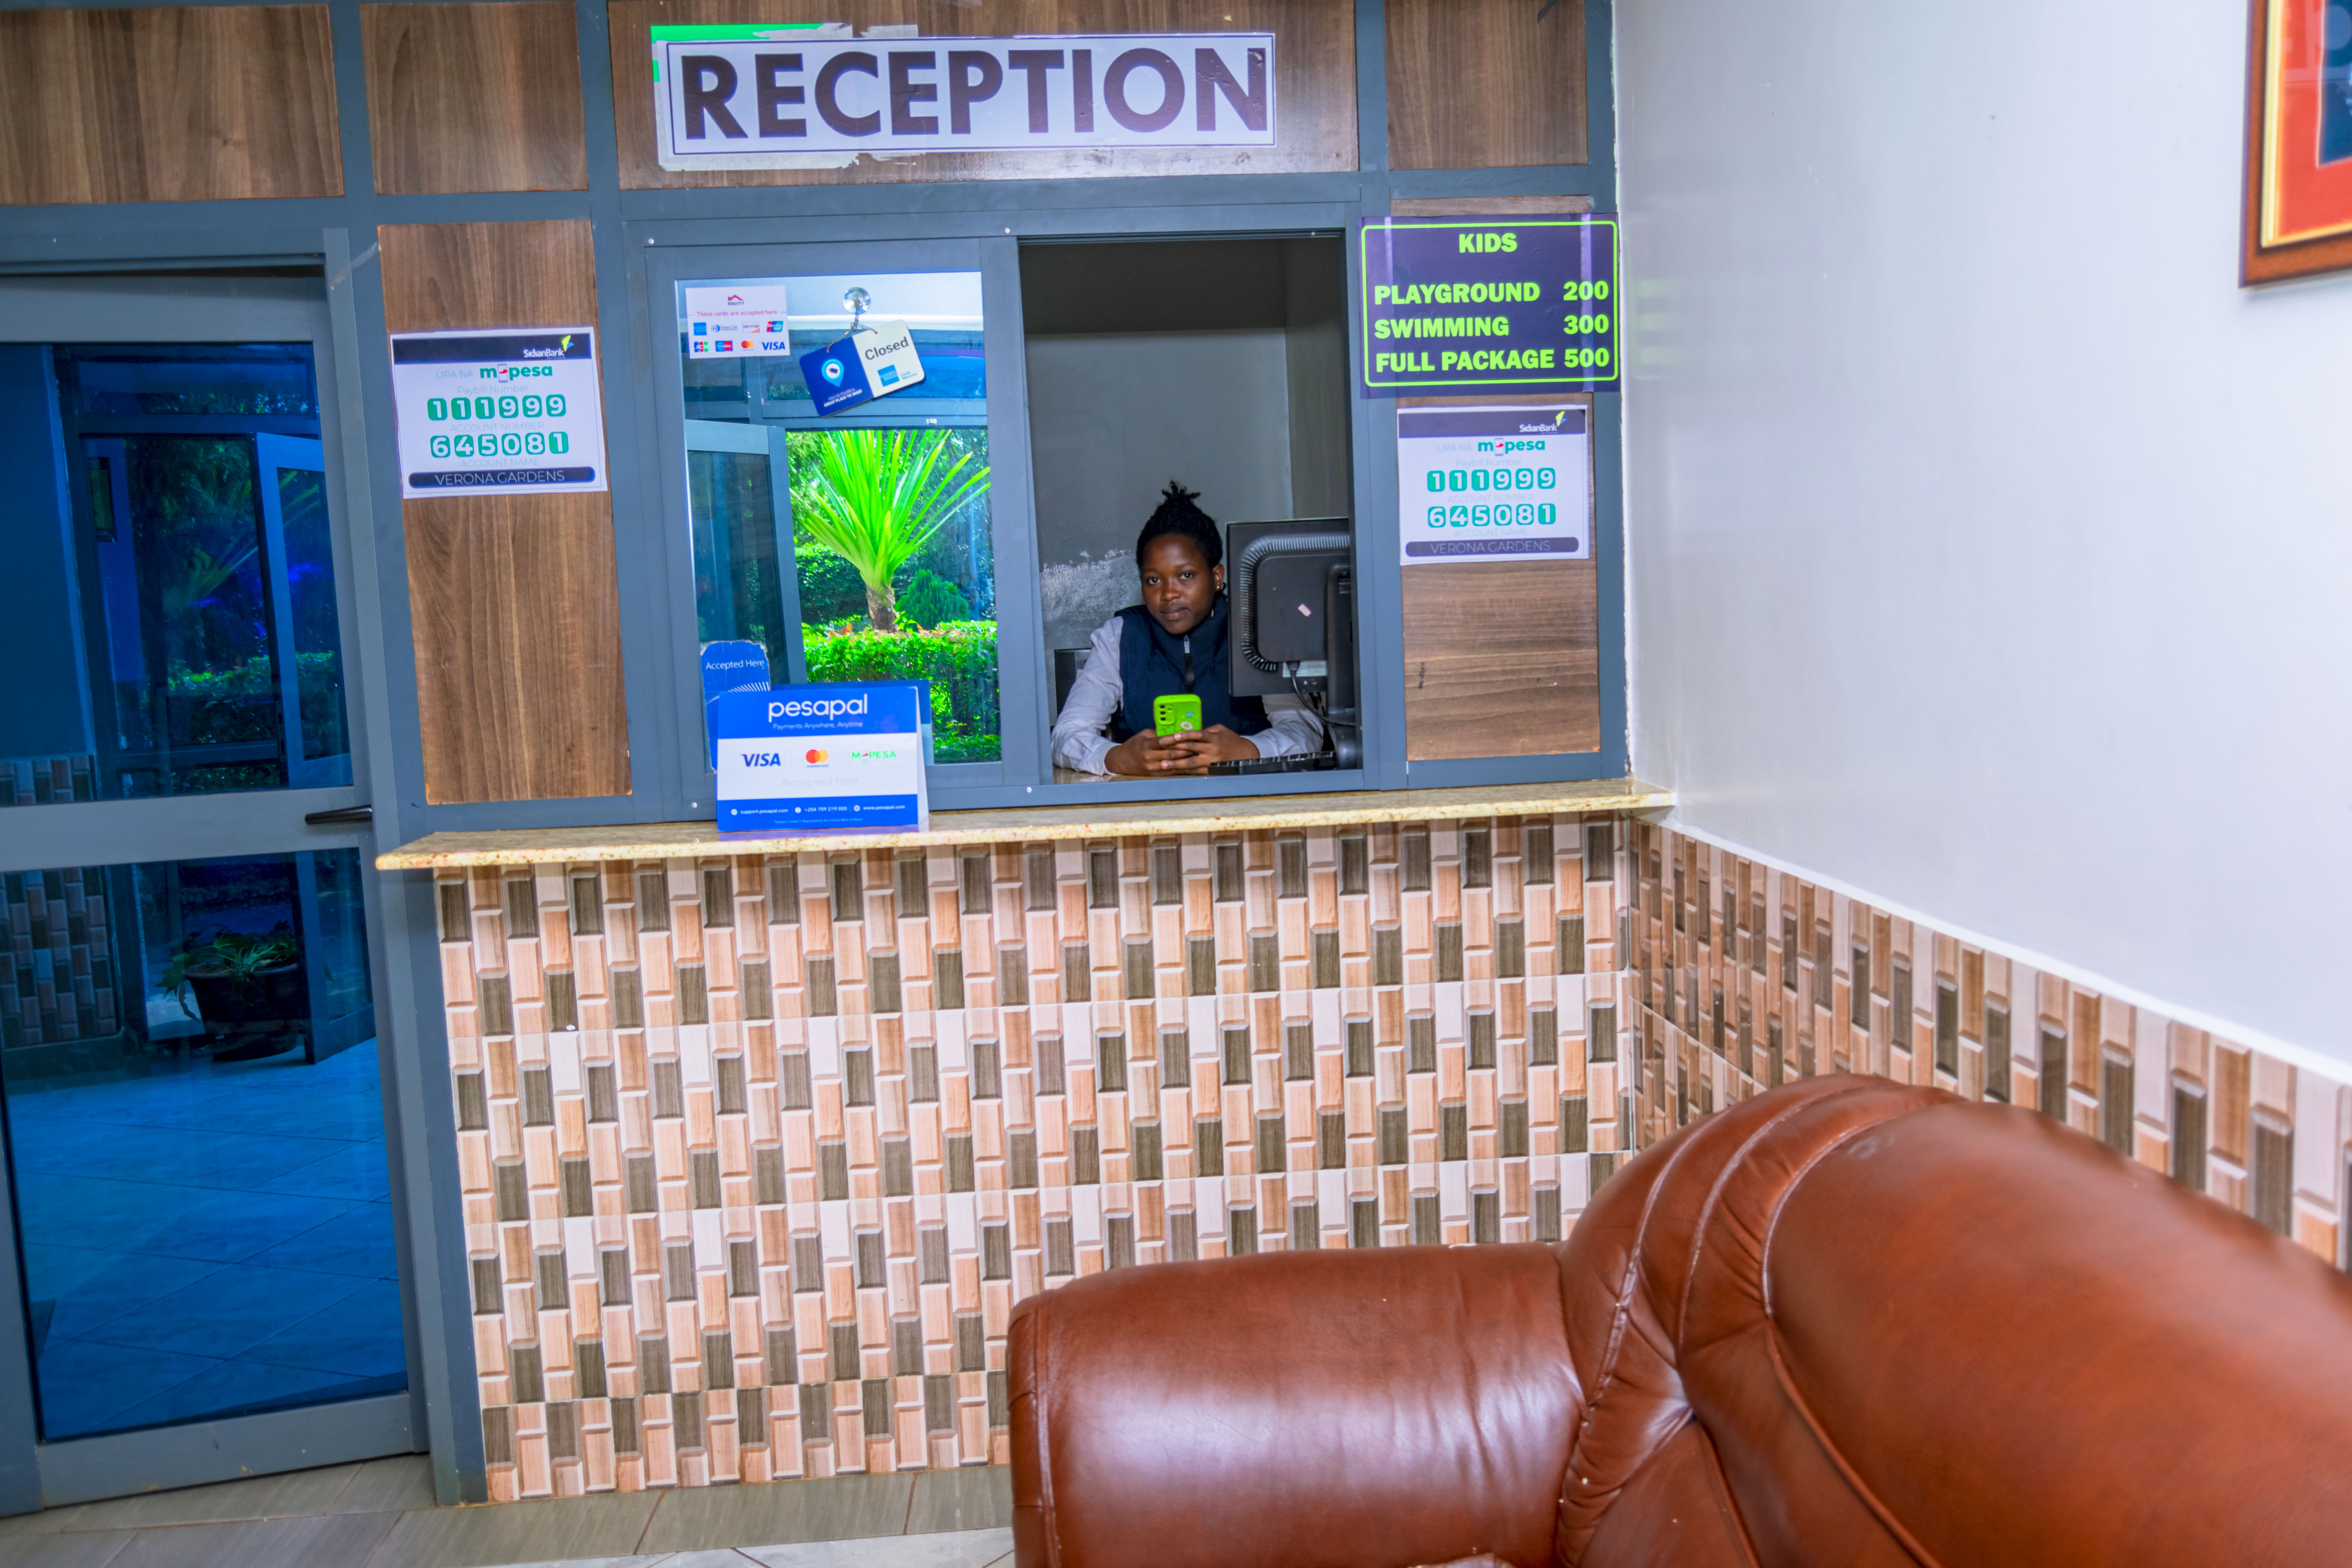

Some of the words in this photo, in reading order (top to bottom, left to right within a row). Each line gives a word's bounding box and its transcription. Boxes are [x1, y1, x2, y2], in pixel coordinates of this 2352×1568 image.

[680, 47, 1268, 140] RECEPTION
[1459, 233, 1517, 253] KIDS
[1374, 282, 1540, 305] PLAYGROUND
[1563, 280, 1608, 301] 200
[1374, 317, 1509, 339] SWIMMING
[1563, 314, 1609, 335] 300
[761, 341, 786, 350] VISA
[865, 336, 909, 360] Closed
[1376, 352, 1435, 372] FULL
[1441, 349, 1555, 371] PACKAGE
[1564, 347, 1610, 368] 500
[436, 370, 457, 379] LIPA
[457, 386, 487, 395] Paybill
[490, 385, 528, 393] Number
[451, 423, 497, 432] ACCOUNT
[501, 422, 544, 430] NUMBER
[1437, 444, 1456, 452] LIPA
[461, 459, 508, 468] ACCOUNT
[1456, 459, 1483, 468] Paybill
[1486, 458, 1522, 466] Number
[435, 472, 495, 485] VERONA
[497, 470, 565, 483] GARDENS
[1447, 495, 1492, 503] ACCOUNT
[1494, 494, 1534, 502] NUMBER
[1455, 529, 1499, 537] ACCOUNT
[1430, 542, 1485, 554] VERONA
[1487, 540, 1550, 552] GARDENS
[706, 660, 744, 671] Accepted
[768, 693, 867, 723] pesapal
[740, 753, 781, 767] VISA
[781, 777, 833, 788] Accepted
[836, 776, 859, 785] here
